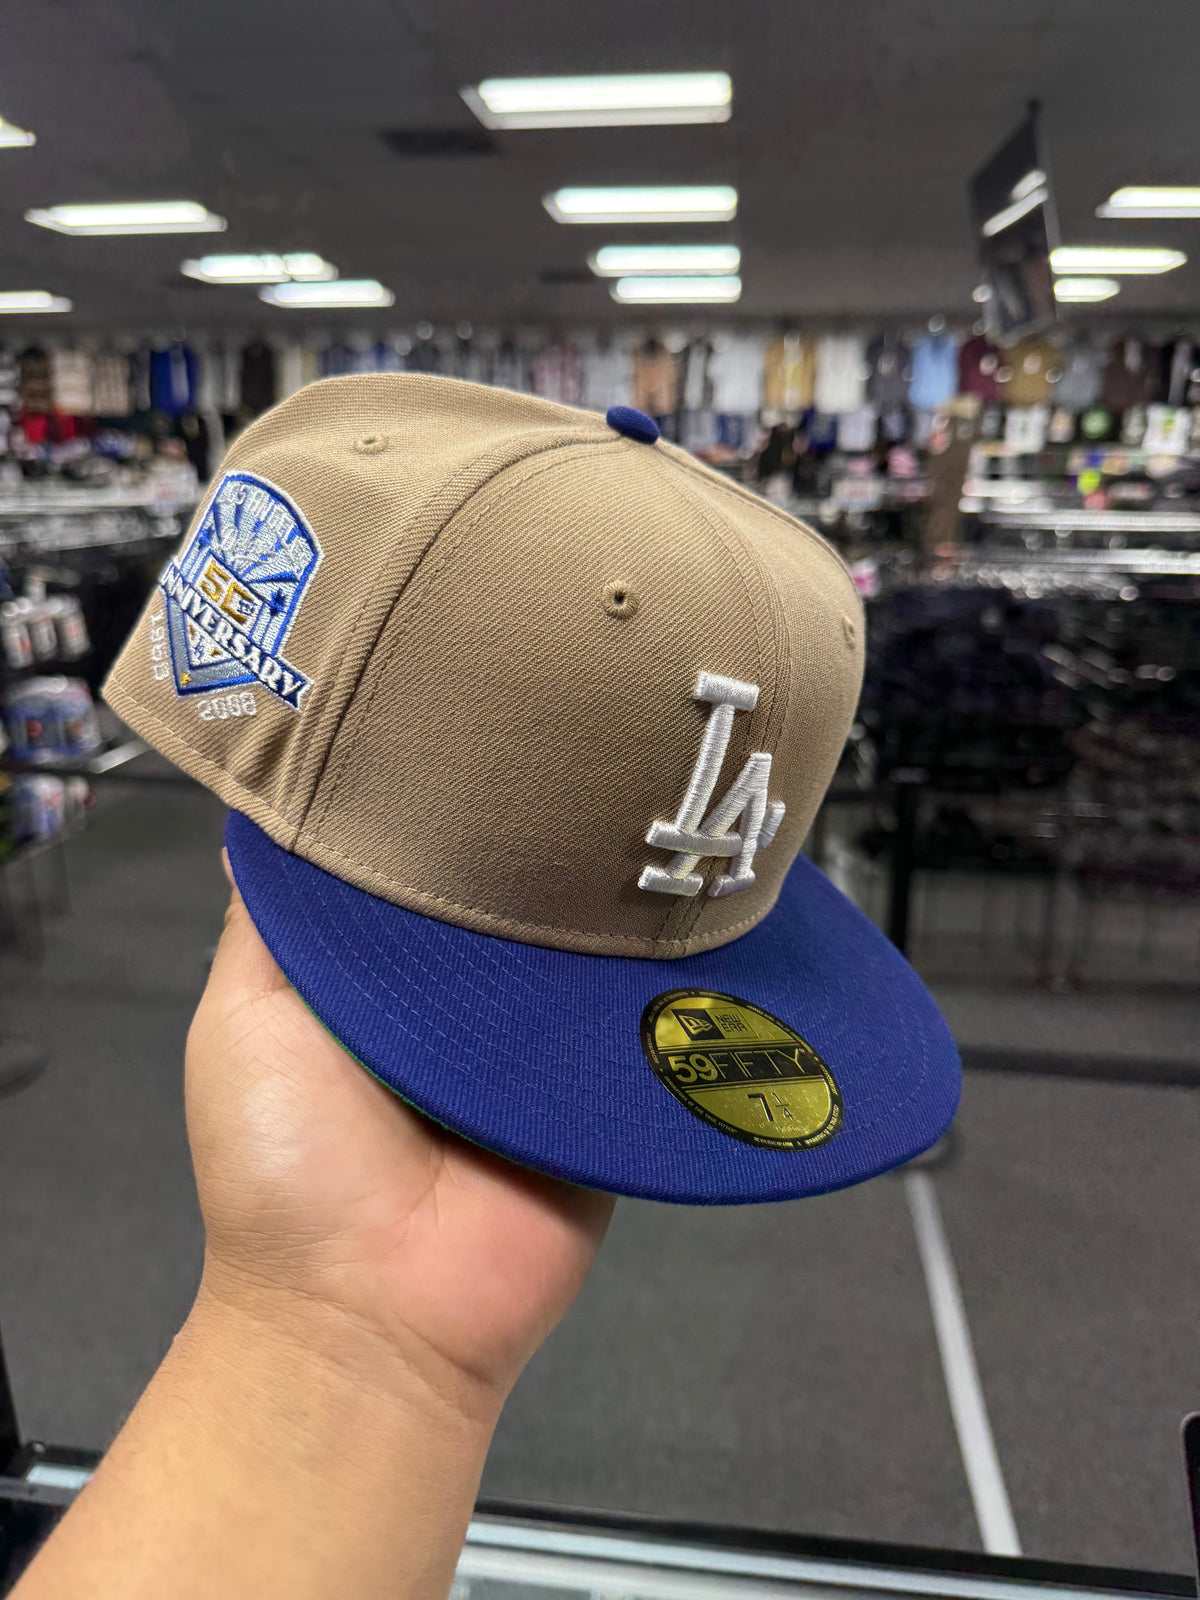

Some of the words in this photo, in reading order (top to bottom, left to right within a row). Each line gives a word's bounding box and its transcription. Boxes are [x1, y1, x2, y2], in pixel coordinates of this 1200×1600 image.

[638, 671, 786, 897] LA
[714, 1014, 742, 1024] NEW
[720, 1023, 749, 1033] ERA
[746, 1092, 774, 1122] 7
